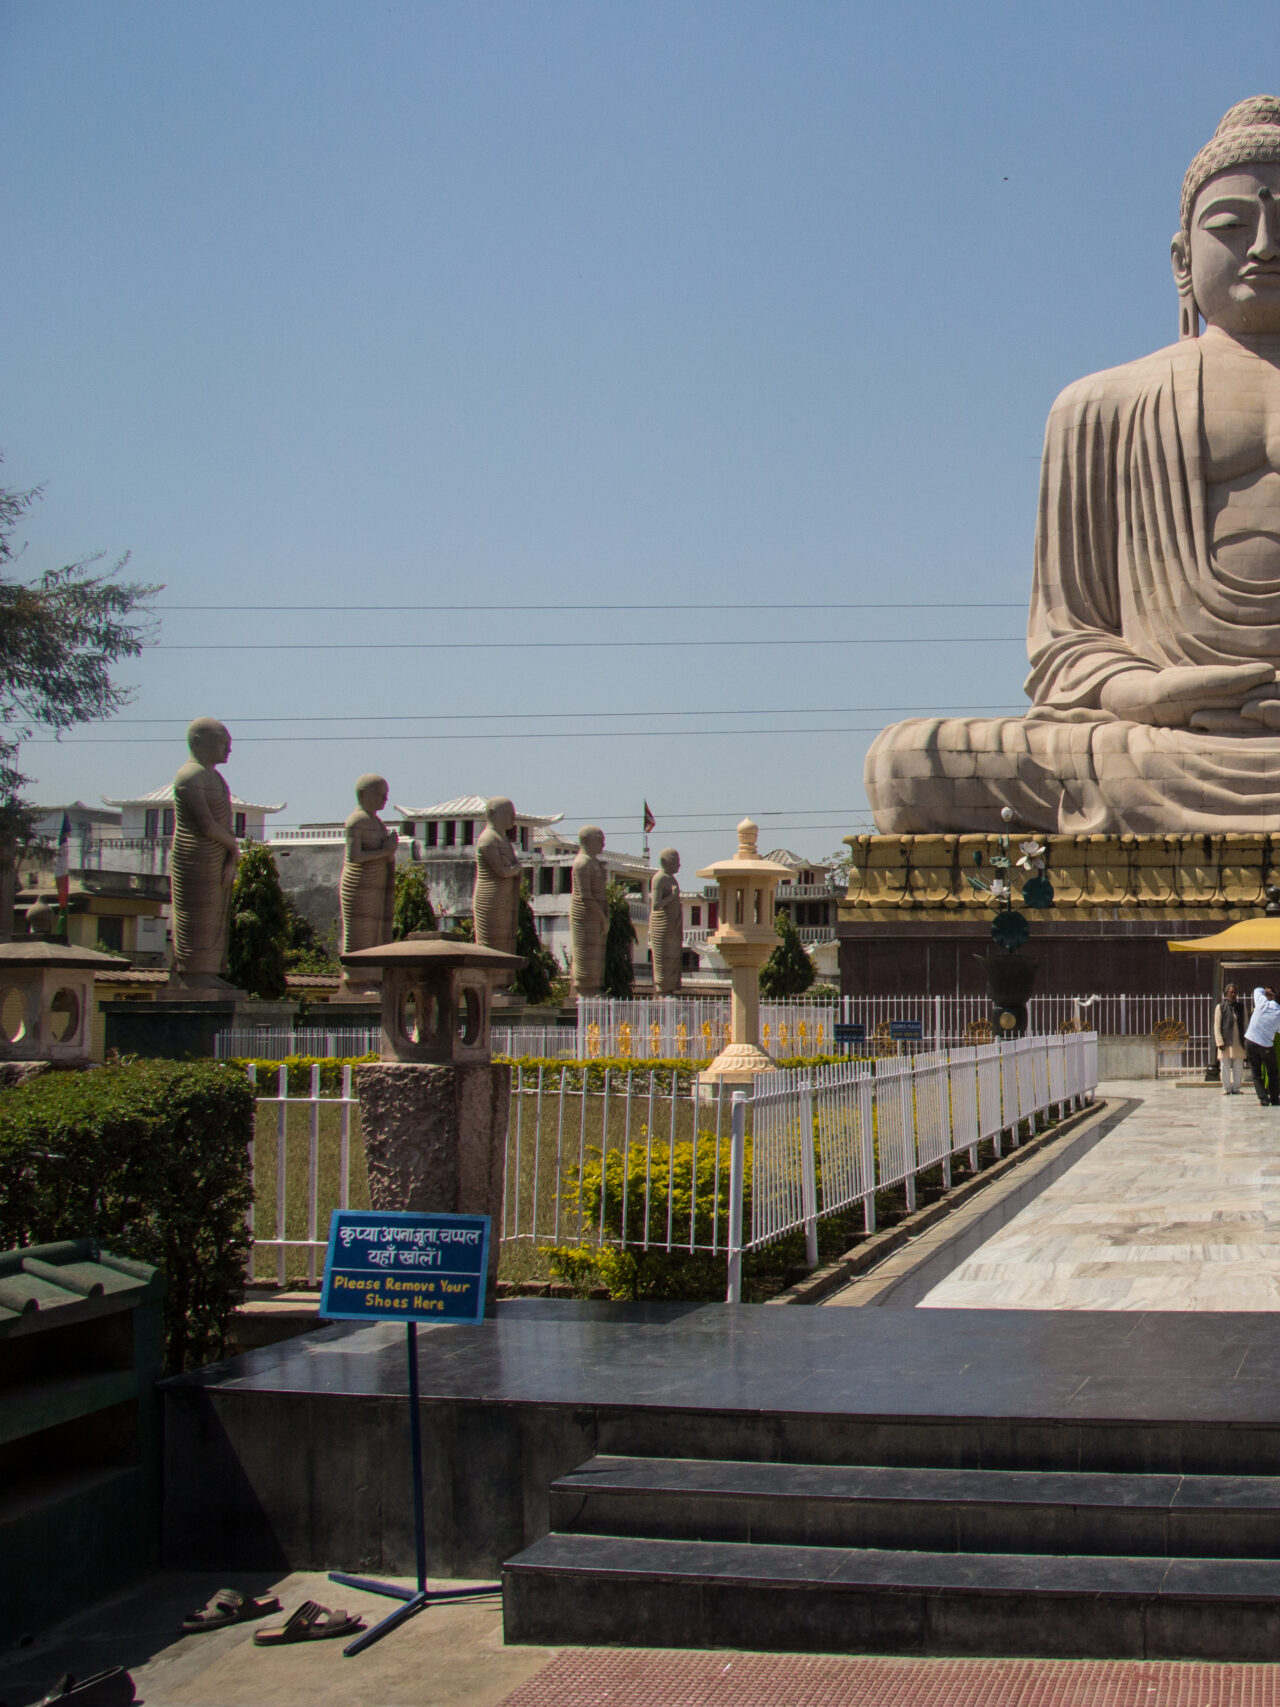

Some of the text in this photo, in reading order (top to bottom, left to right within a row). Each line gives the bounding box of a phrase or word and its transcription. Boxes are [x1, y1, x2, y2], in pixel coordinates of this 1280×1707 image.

[380, 1226, 413, 1242] अपना
[367, 1244, 397, 1267] यहाँ
[334, 1276, 471, 1292] Please Remove Your
[365, 1294, 445, 1310] Shoes Here
